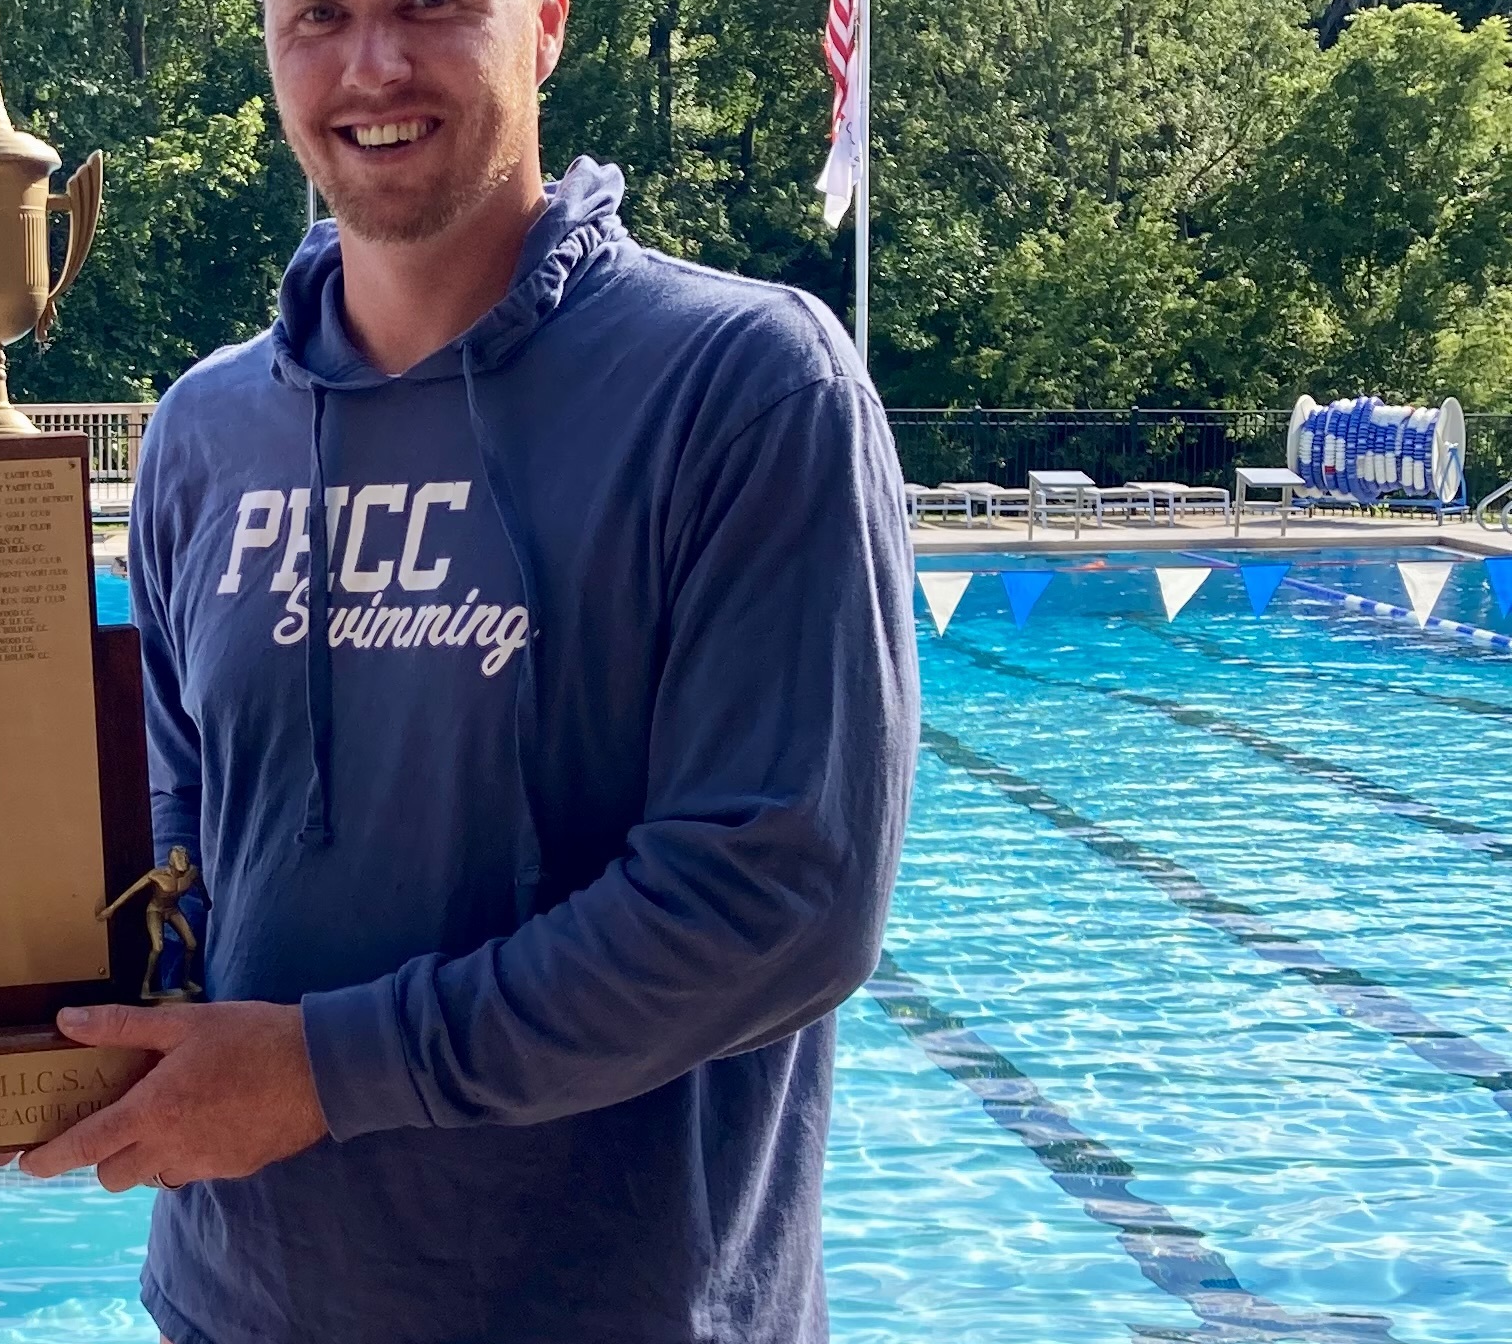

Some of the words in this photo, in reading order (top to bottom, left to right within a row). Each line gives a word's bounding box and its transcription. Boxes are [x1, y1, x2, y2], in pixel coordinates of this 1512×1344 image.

[5, 470, 29, 479] YACHT
[32, 469, 52, 478] CLUB
[5, 484, 31, 492] YACHT
[33, 482, 54, 491] CLUB
[5, 497, 25, 505] CLUB
[42, 495, 74, 504] DETROIT
[6, 511, 25, 519] GOLF
[30, 510, 51, 518] CLUB
[5, 523, 25, 532] GOLF
[29, 522, 52, 531] CLUB
[217, 480, 472, 594] PHCC
[8, 545, 30, 554] HILLS
[39, 557, 62, 565] CLUB
[2, 585, 20, 594] RUN
[22, 584, 43, 593] GOLF
[45, 584, 67, 592] CLUB
[0, 597, 17, 605] RUN
[21, 596, 40, 604] GOLF
[44, 595, 65, 603] CLUB
[3, 626, 34, 634] HOLLOW
[273, 578, 540, 677] Swimming
[4, 653, 35, 662] HOLLOW
